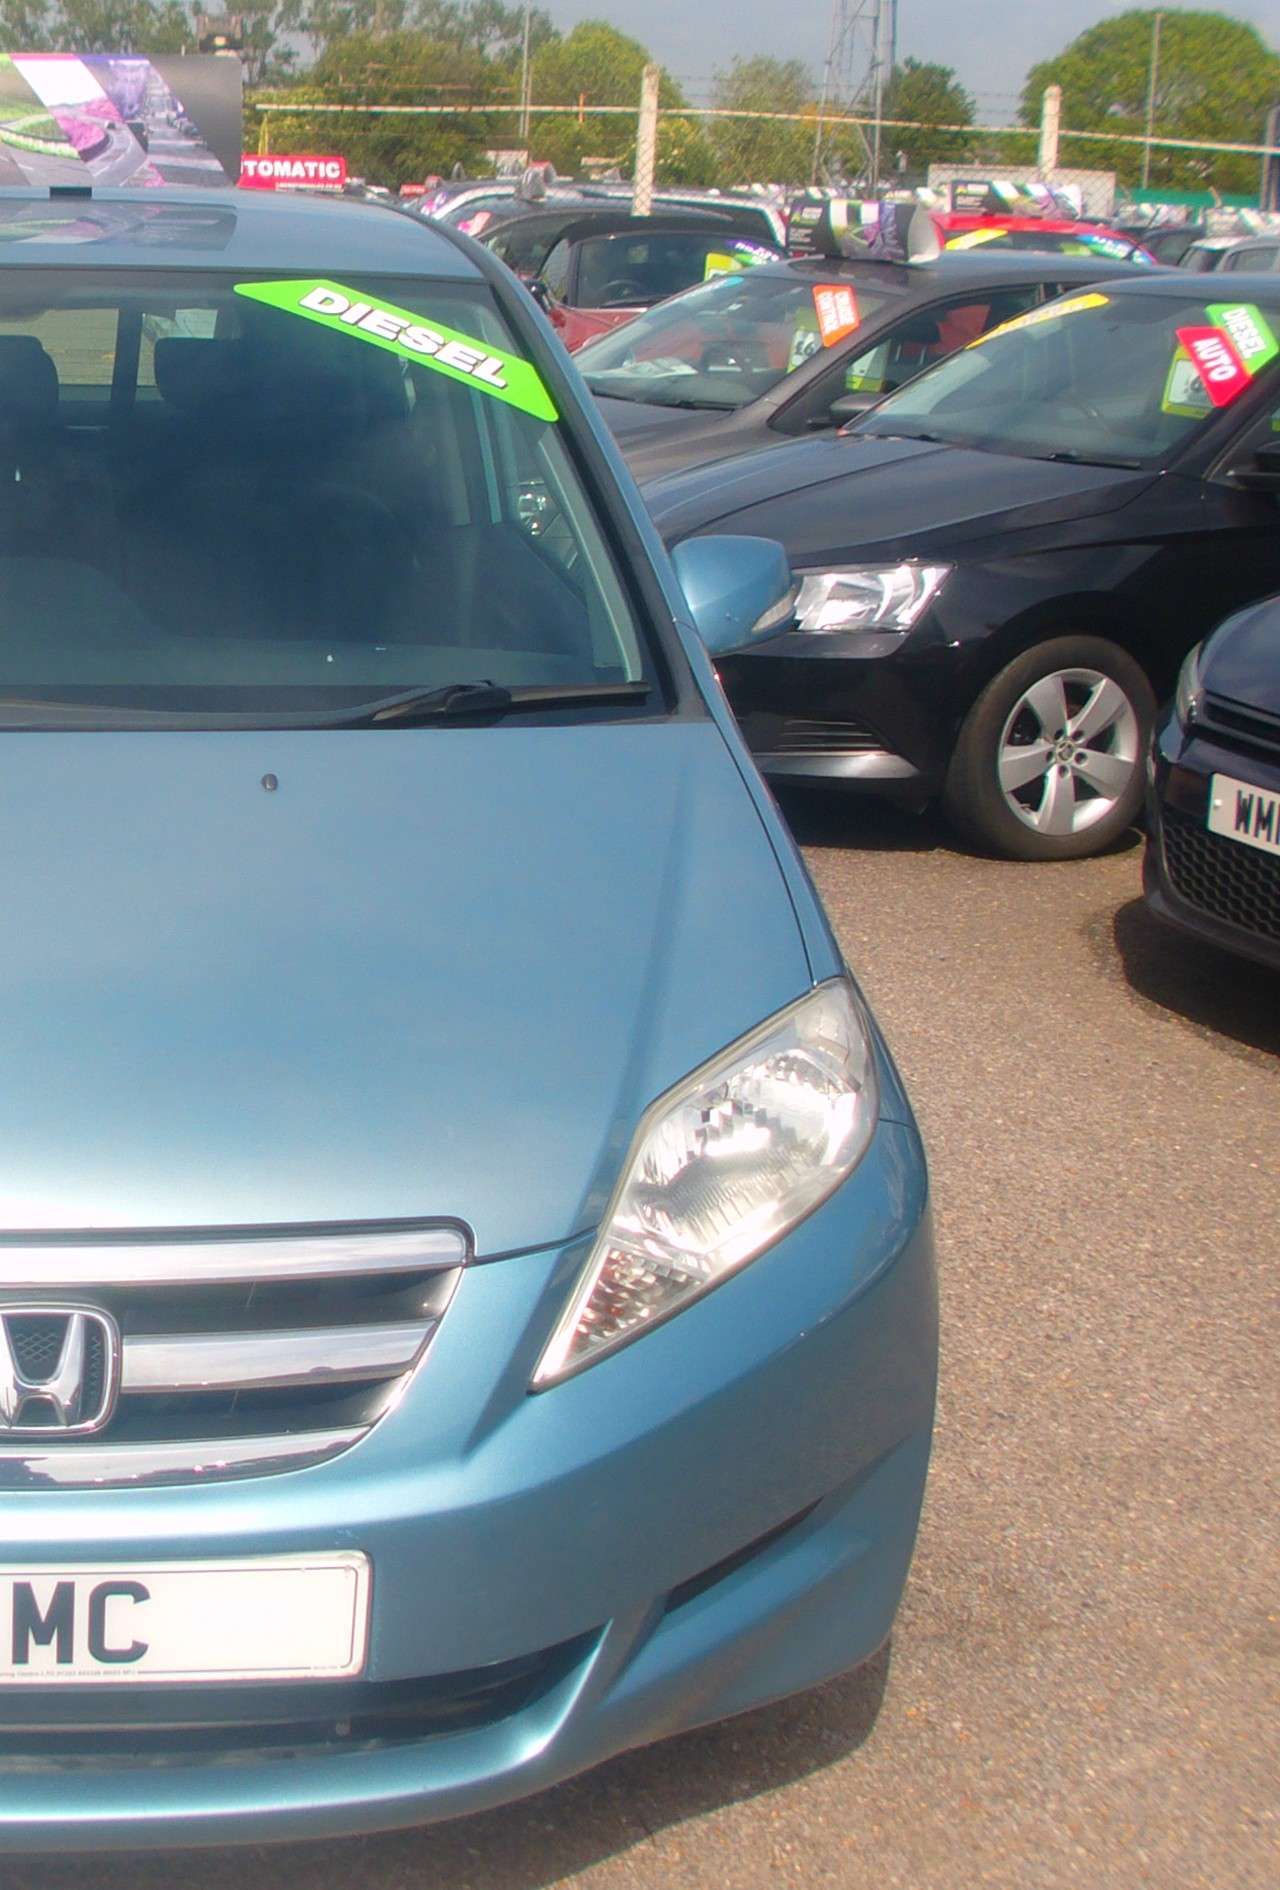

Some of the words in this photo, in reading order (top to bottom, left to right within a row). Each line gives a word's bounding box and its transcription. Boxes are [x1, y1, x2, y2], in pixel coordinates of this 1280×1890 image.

[240, 160, 341, 179] TOMATIC
[298, 286, 508, 389] DIESEL
[1221, 306, 1268, 359] DIESEL
[1192, 336, 1238, 382] AUTO
